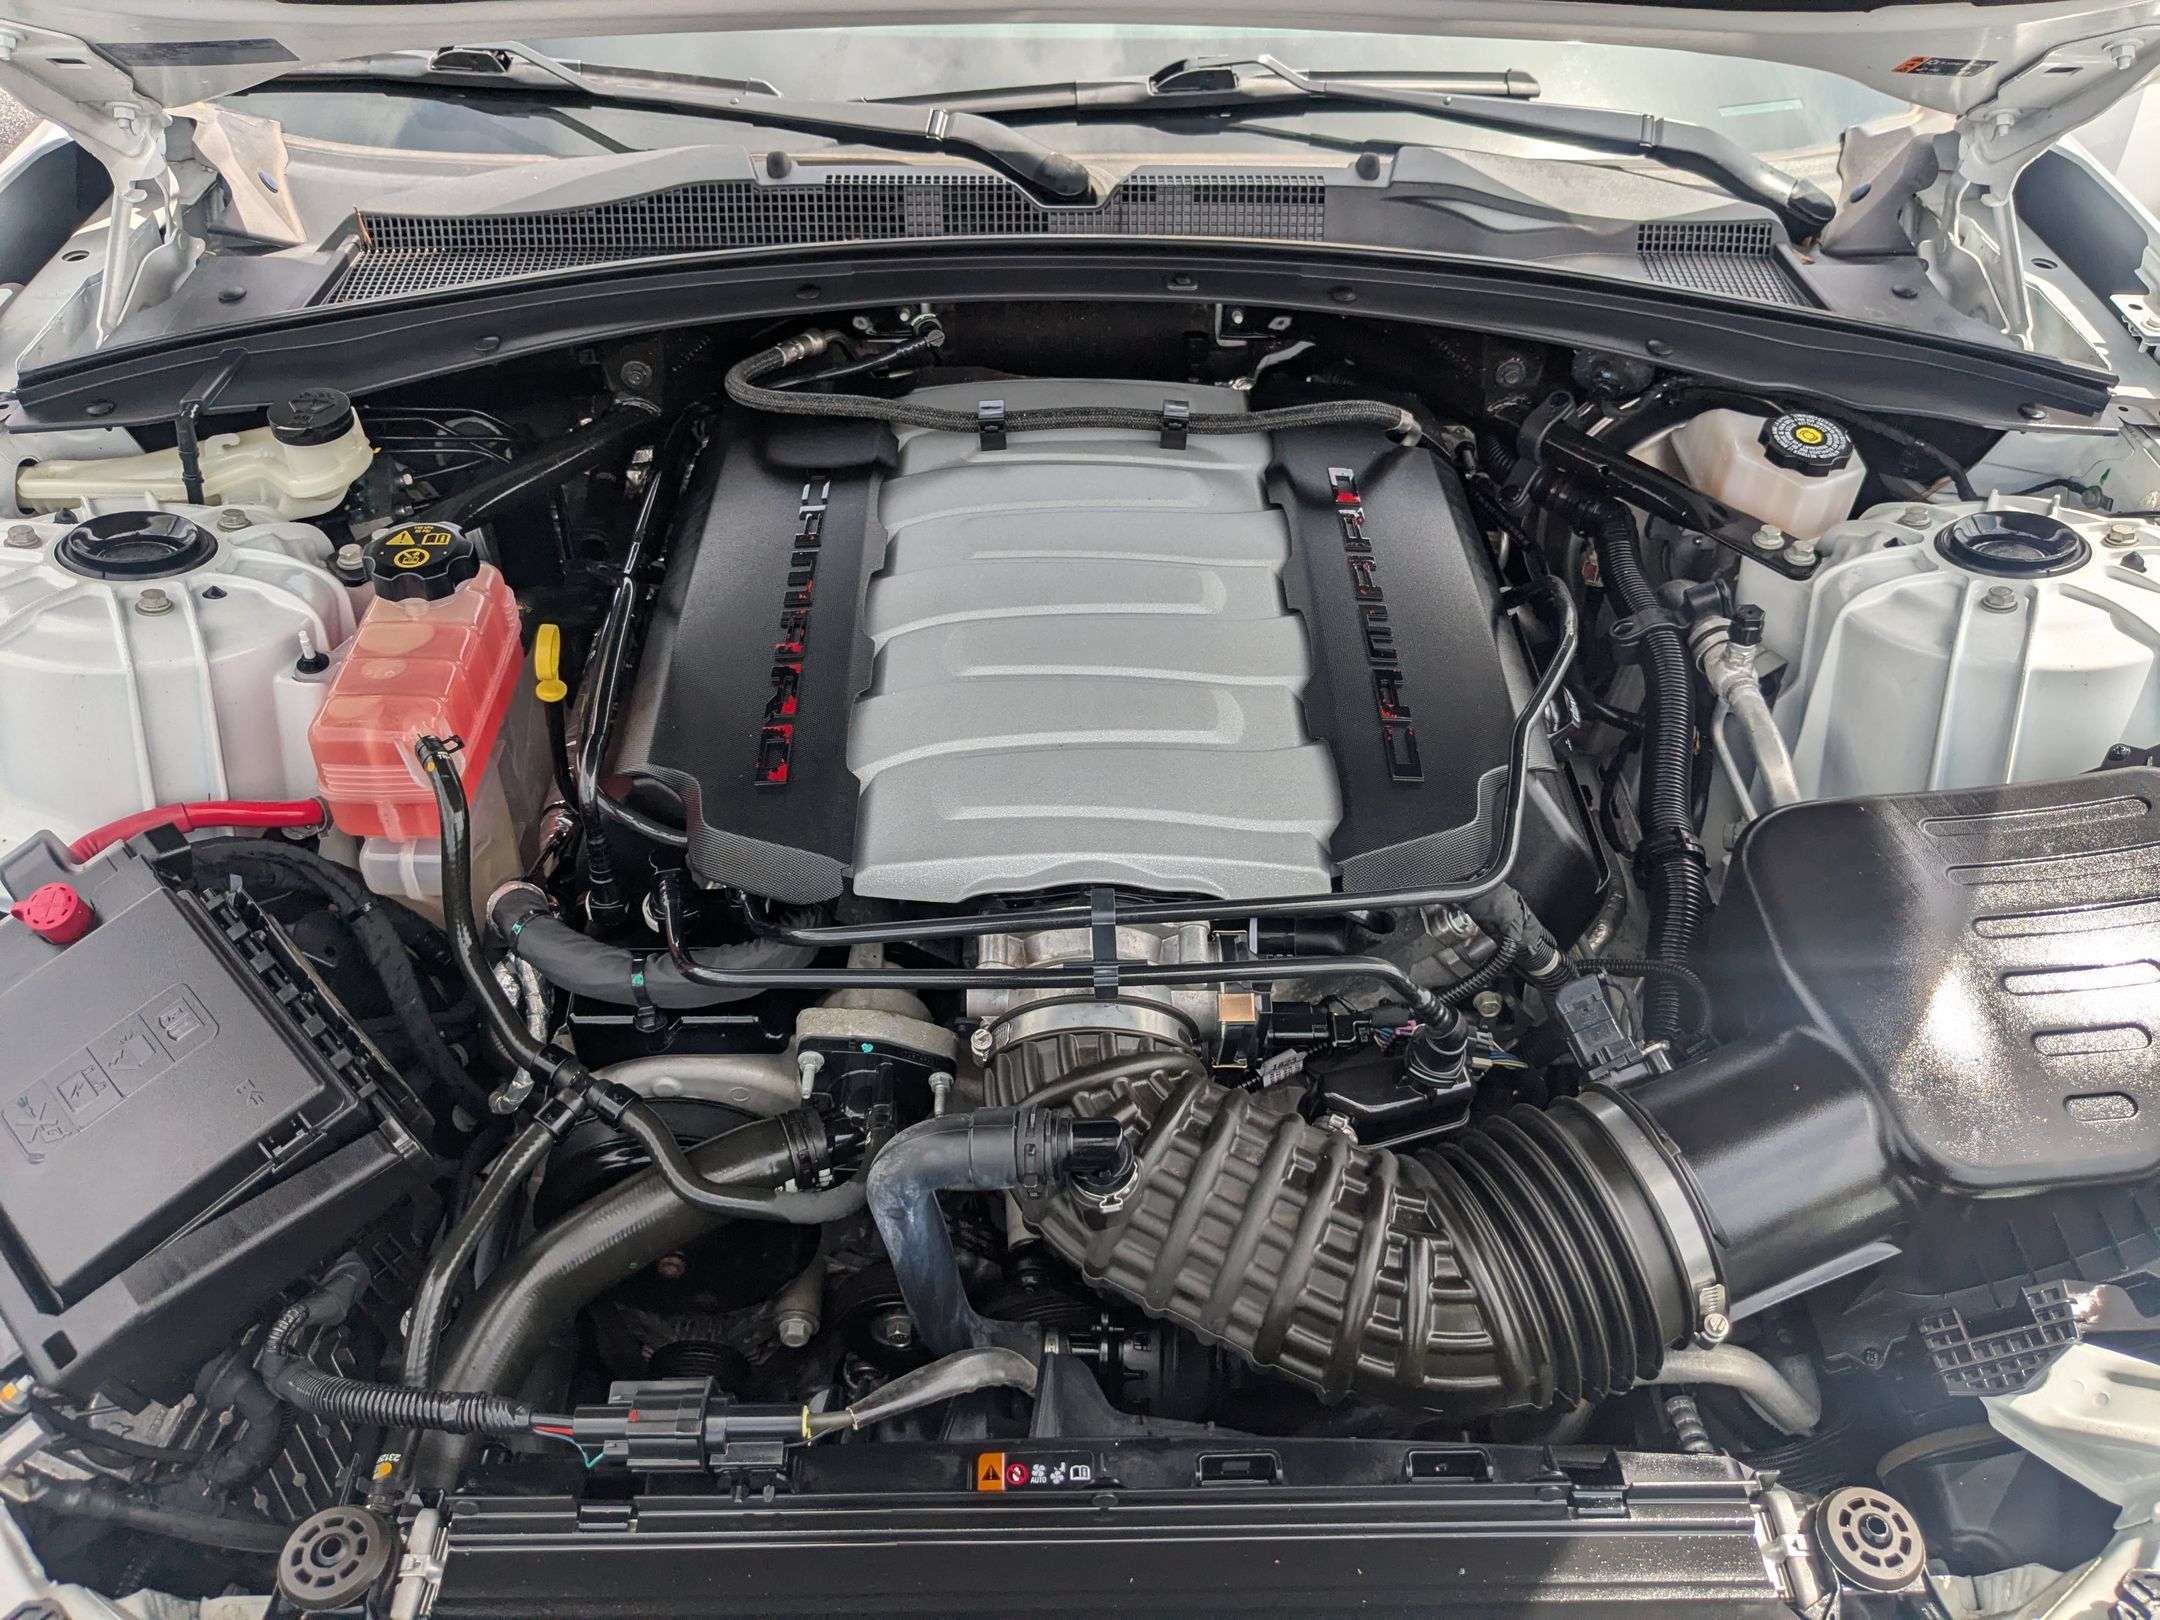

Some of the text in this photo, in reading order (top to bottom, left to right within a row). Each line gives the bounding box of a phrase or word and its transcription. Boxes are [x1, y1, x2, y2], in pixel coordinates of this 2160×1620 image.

[754, 468, 831, 787] CAMARO
[1328, 467, 1425, 782] CAMARO
[1030, 1476, 1047, 1484] AUTO
